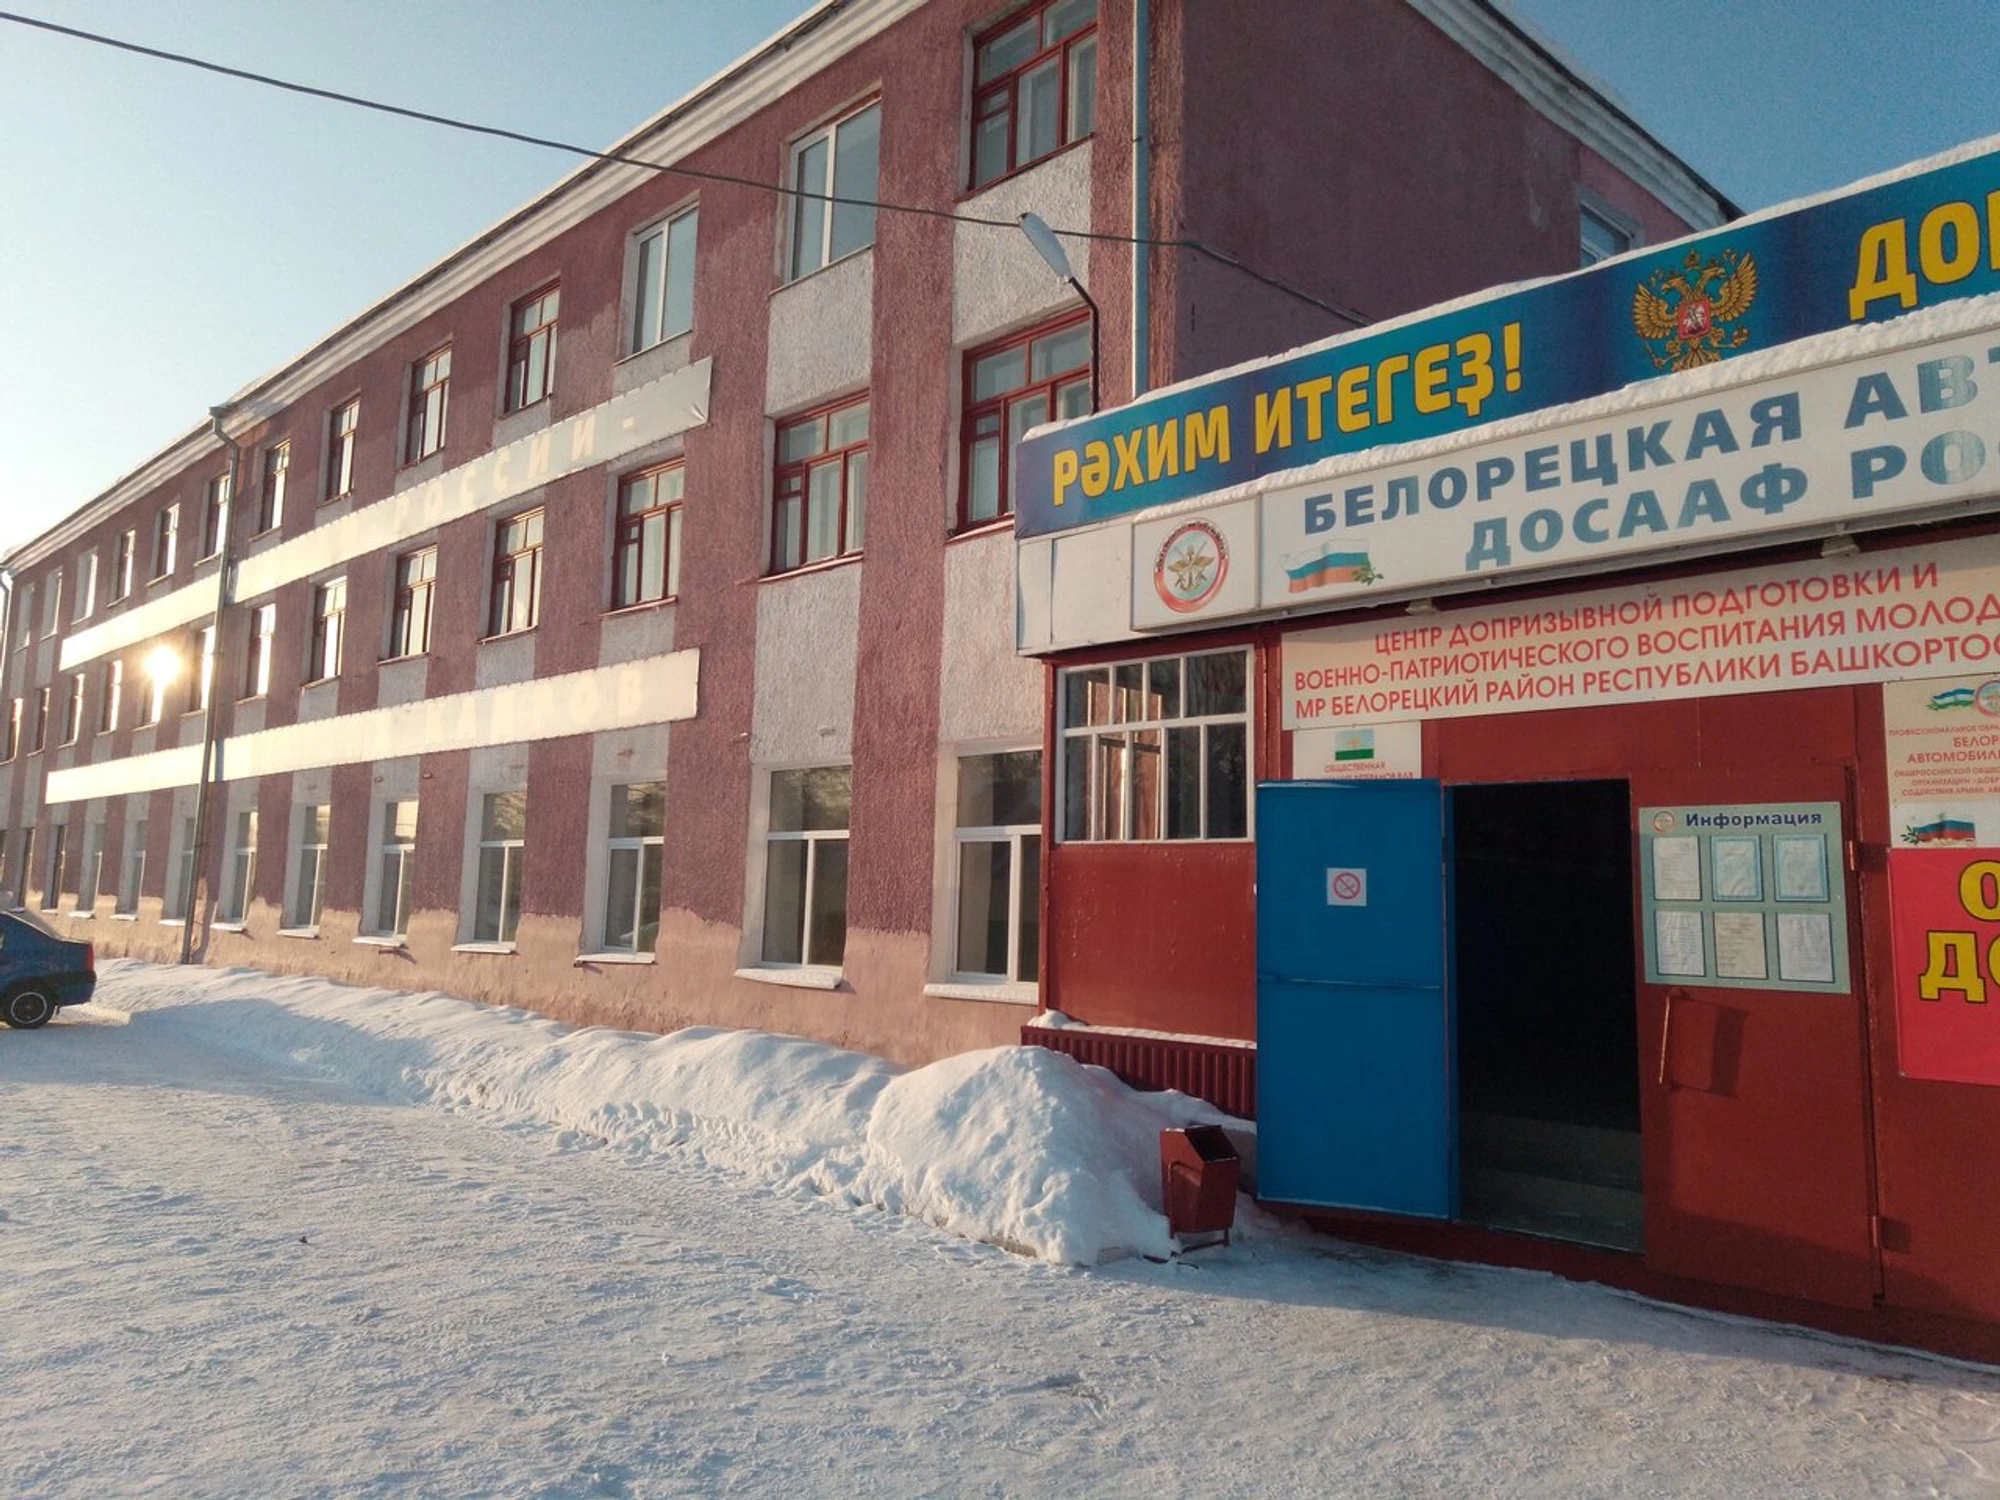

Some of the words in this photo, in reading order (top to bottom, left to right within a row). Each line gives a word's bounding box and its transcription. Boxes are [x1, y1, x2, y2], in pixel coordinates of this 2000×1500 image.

[1053, 405, 1231, 507] РӘХИМ
[1849, 188, 2000, 321] ДО
[395, 414, 596, 523] РОССИИ
[1304, 392, 1802, 535] БЕЛОРЕЦКАЯ
[1466, 463, 1808, 571] ДОСААФ
[1850, 430, 2000, 500] РО
[1295, 636, 1629, 691] ВОЕННО-ПАТРИОТИЧЕСКОГО
[1637, 610, 1845, 656] ВОСПИТАНИЯ
[1375, 626, 1443, 656] ЦЕНТР
[1449, 593, 1663, 647] ДОПРИЗЫВНОЙ
[1673, 567, 1901, 618] ПОДГОТОВКИ
[1913, 562, 1938, 590] И
[1296, 699, 1326, 719] МР
[1332, 673, 1479, 717] БЕЛОРЕЦКИЙ
[1487, 673, 1575, 702] РАЙОН
[1583, 653, 1781, 695] РЕСПУБЛИКИ
[1791, 633, 2000, 676] БАШКОРТО
[1953, 735, 2000, 748] БЕЛОР
[1685, 812, 1822, 828] Информация
[1918, 930, 2000, 1003] Д
